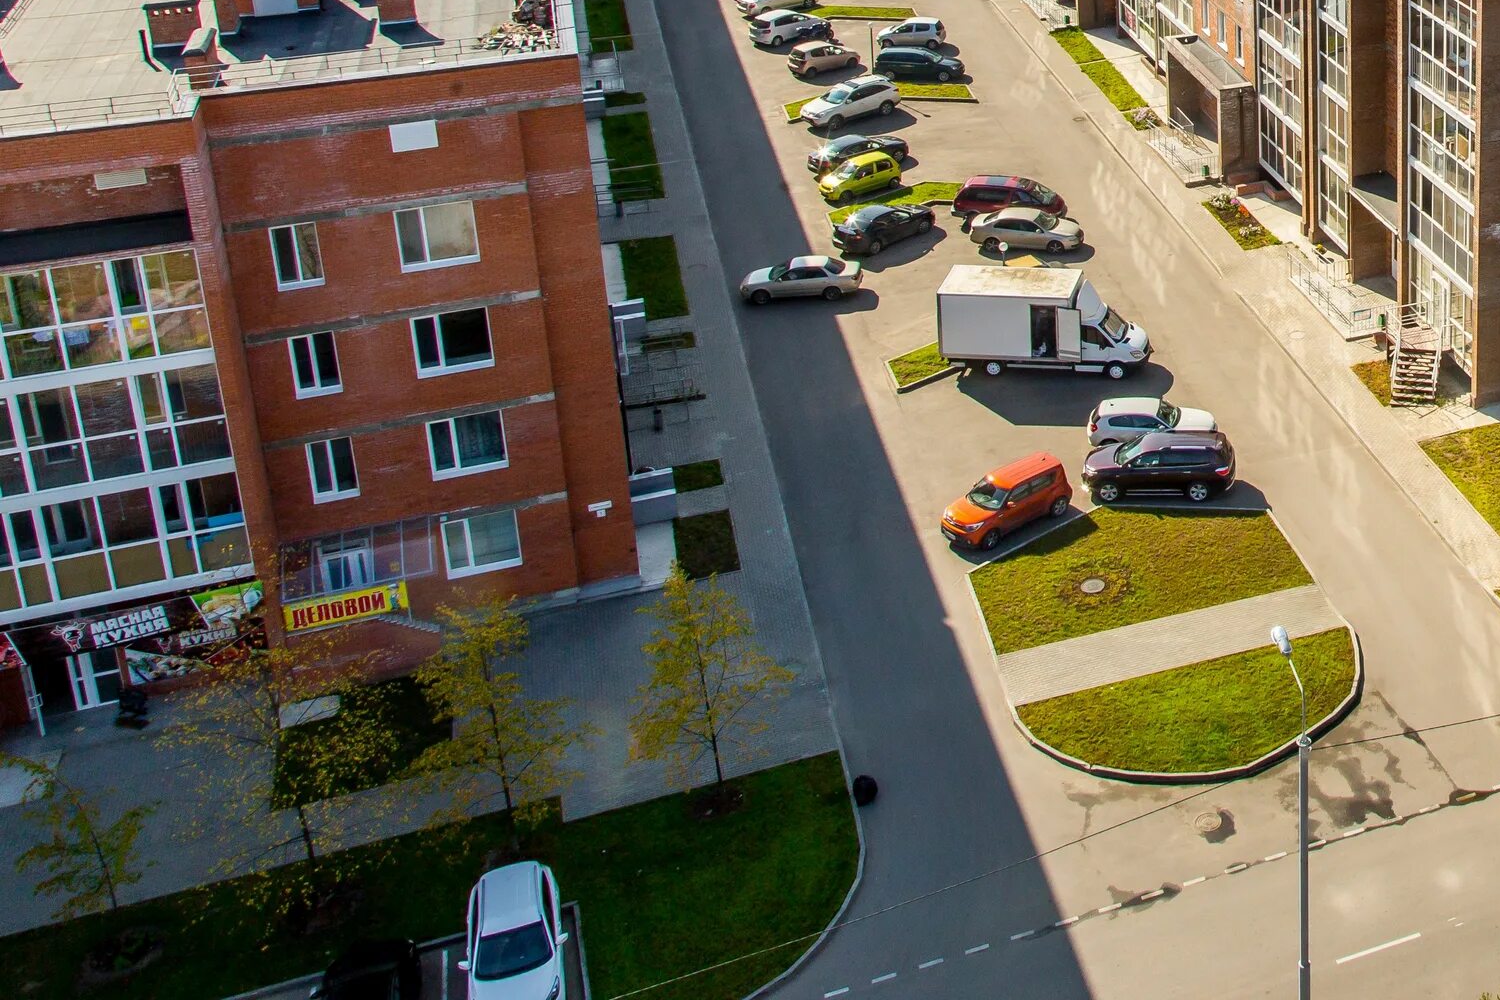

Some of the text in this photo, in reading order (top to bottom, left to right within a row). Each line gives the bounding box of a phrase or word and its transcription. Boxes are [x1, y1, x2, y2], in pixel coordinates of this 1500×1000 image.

[91, 606, 165, 634] МЯСНАЯ
[292, 590, 386, 629] ДЕЛОВОЙ
[93, 617, 170, 646] КУХНЯ
